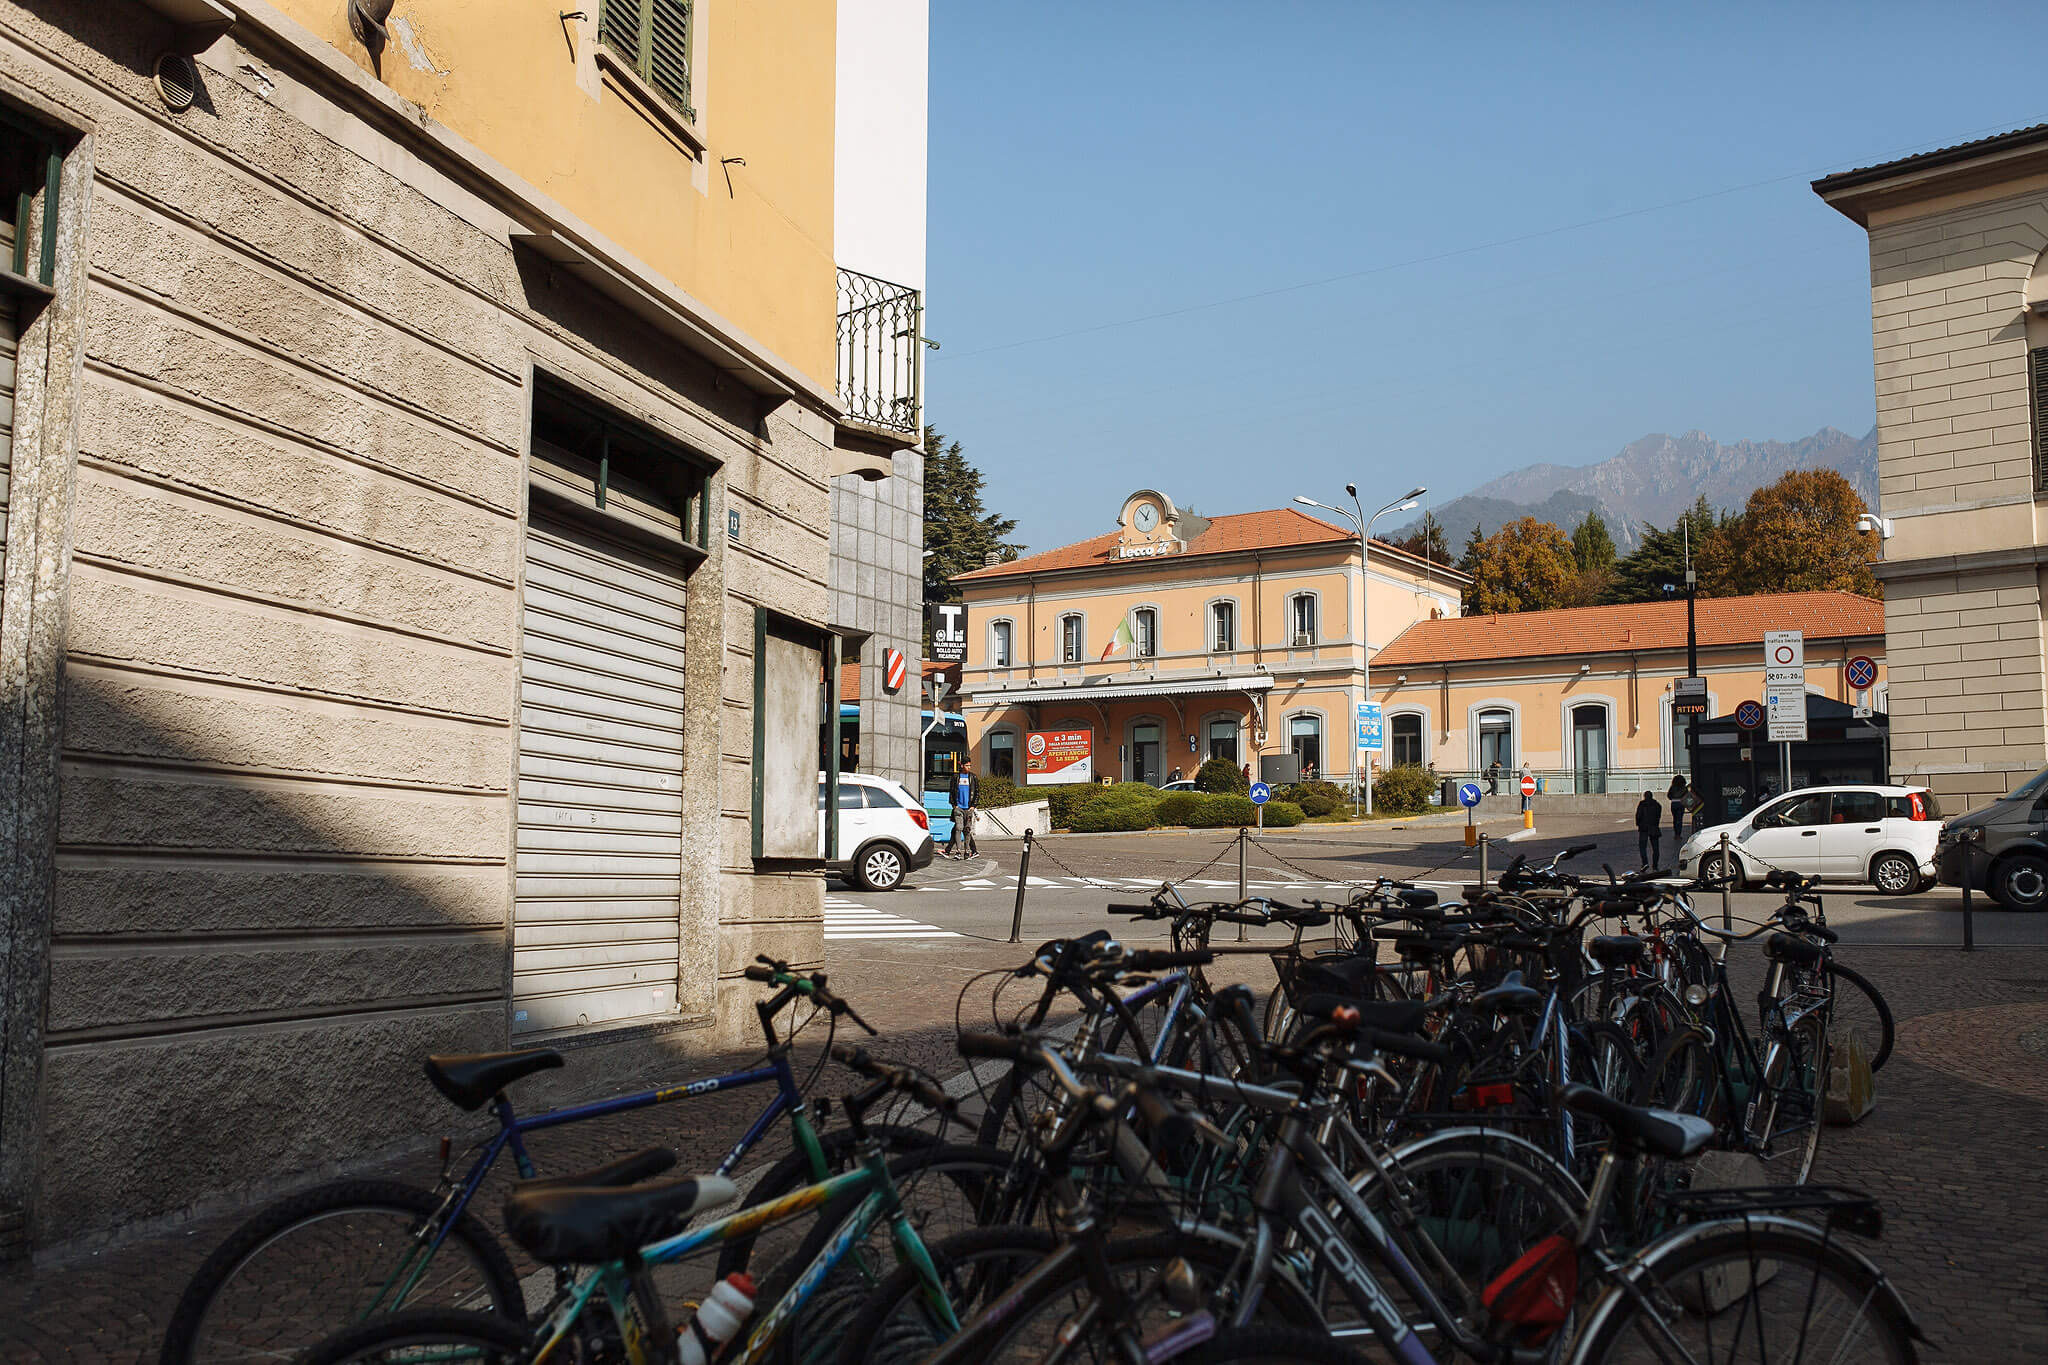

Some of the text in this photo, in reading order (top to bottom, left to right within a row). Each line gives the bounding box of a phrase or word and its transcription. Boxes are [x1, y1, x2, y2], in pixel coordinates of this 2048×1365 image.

[730, 516, 738, 531] 13
[1119, 546, 1154, 558] Lecco
[939, 606, 962, 641] T
[1676, 705, 1705, 713] ATTIVO
[1299, 1206, 1409, 1344] COPPI
